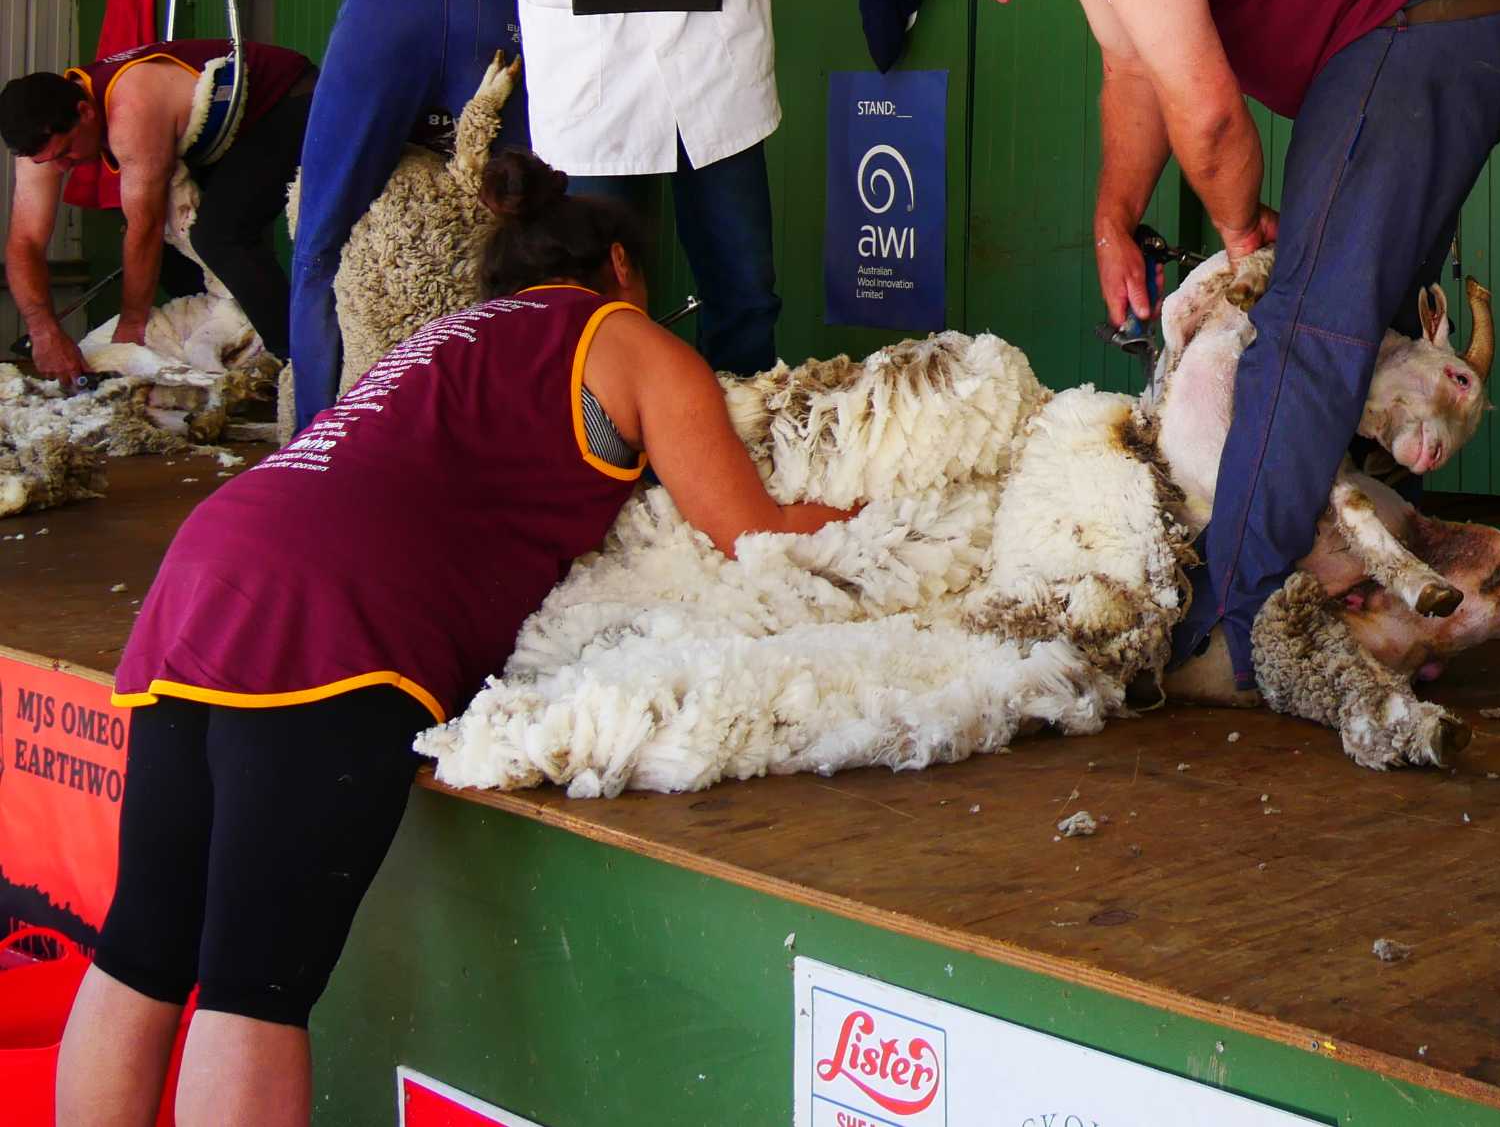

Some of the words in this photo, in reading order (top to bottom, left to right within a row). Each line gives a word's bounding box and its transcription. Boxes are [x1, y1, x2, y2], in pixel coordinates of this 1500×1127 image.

[857, 265, 893, 276] Australian
[857, 277, 877, 288] Wool
[877, 278, 914, 290] Innovation
[855, 289, 885, 300] Limited
[17, 687, 56, 734] MJS
[61, 701, 126, 751] OMEO
[816, 1010, 941, 1116] Lister
